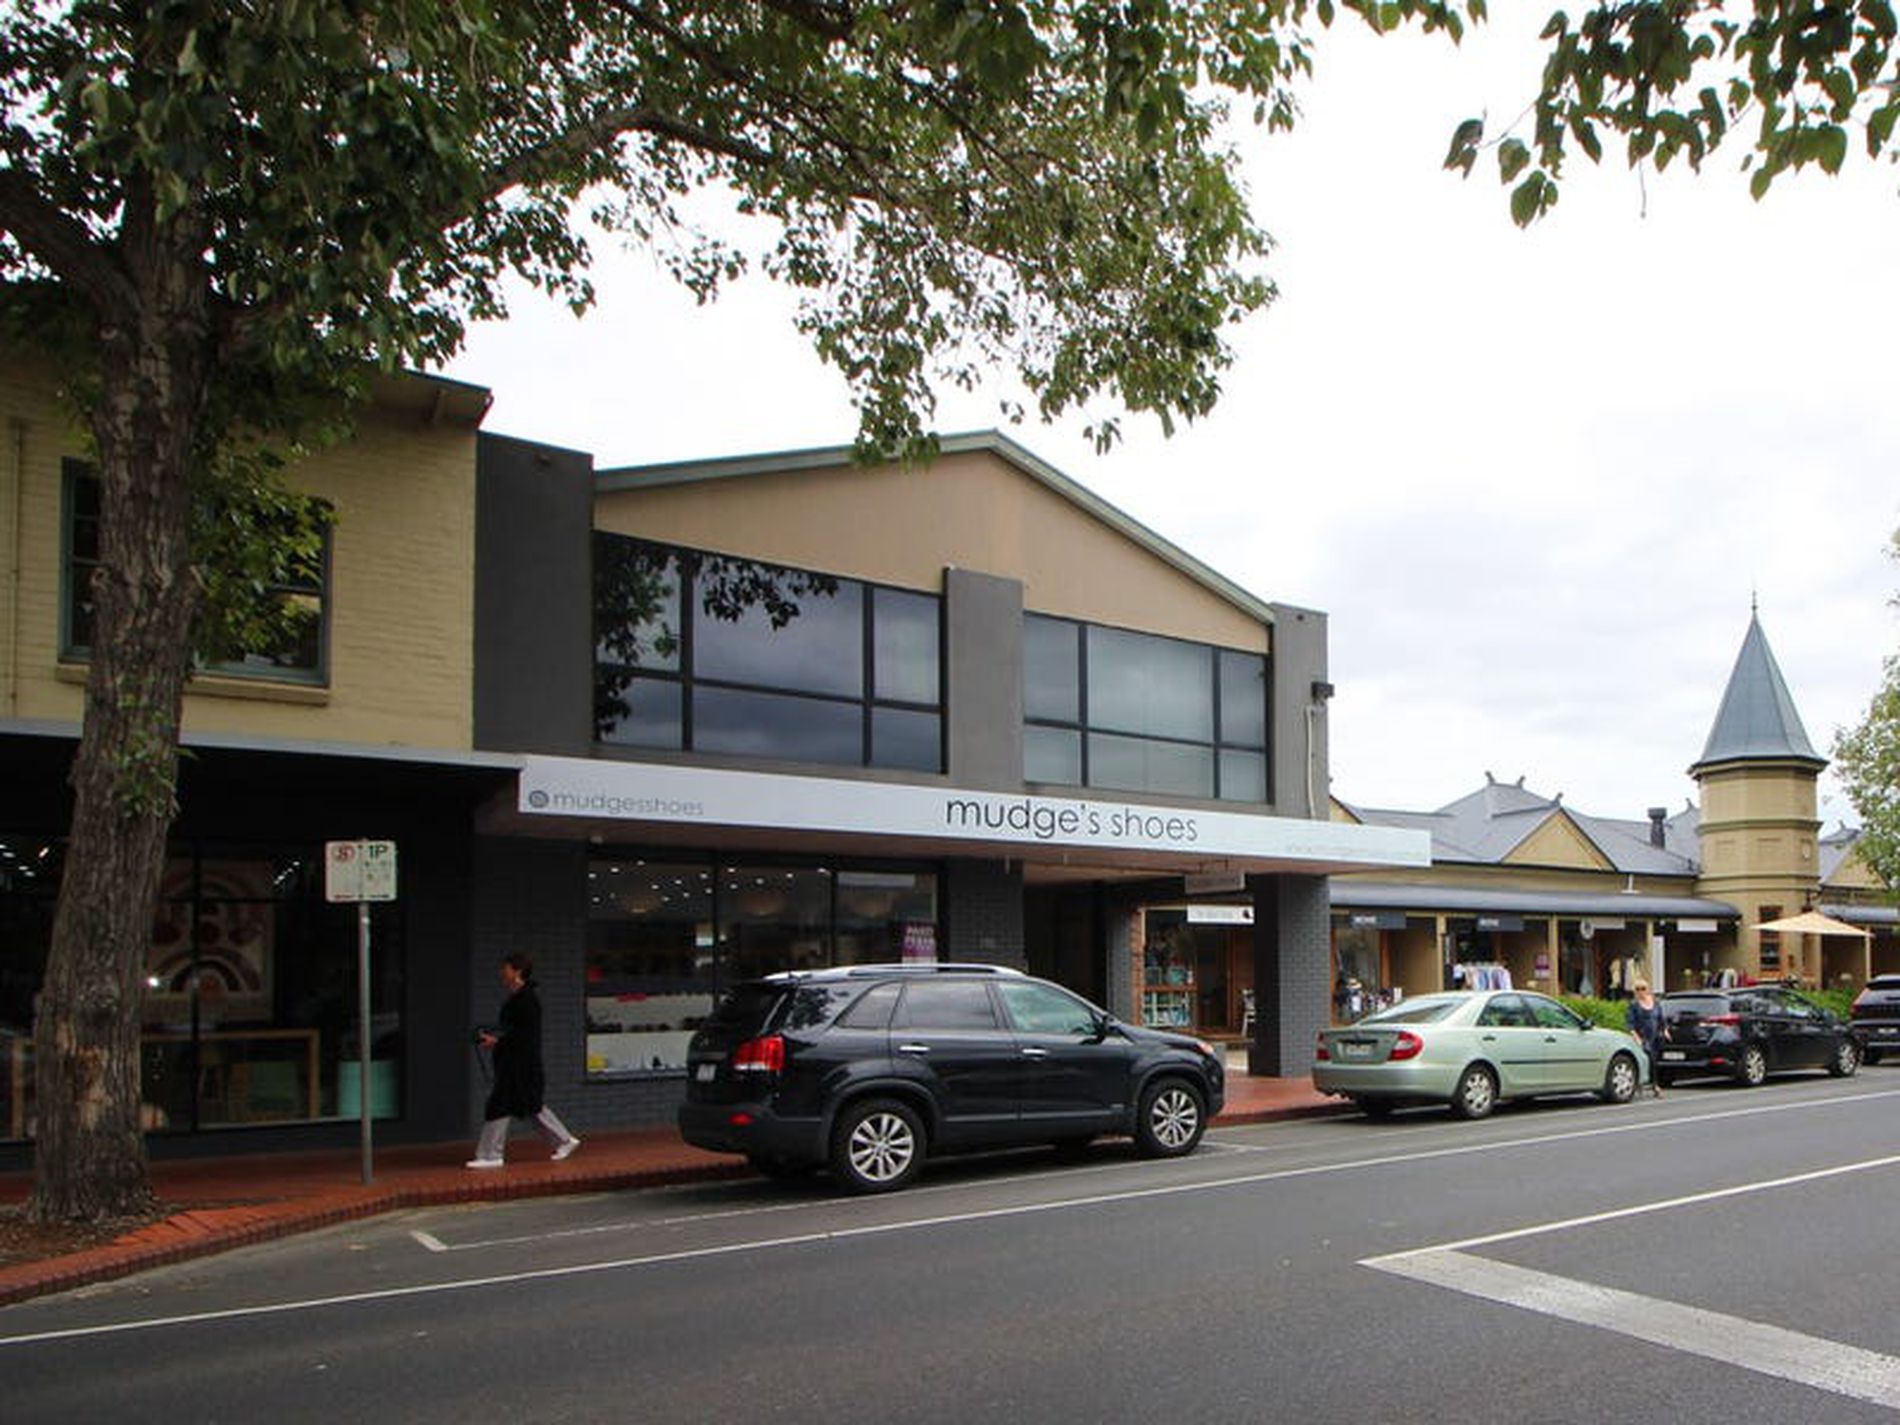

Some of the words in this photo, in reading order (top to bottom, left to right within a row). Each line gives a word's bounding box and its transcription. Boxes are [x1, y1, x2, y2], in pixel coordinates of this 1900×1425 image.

[946, 799, 1100, 839] mudge's
[1111, 808, 1198, 841] shoes
[369, 844, 388, 859] 1P
